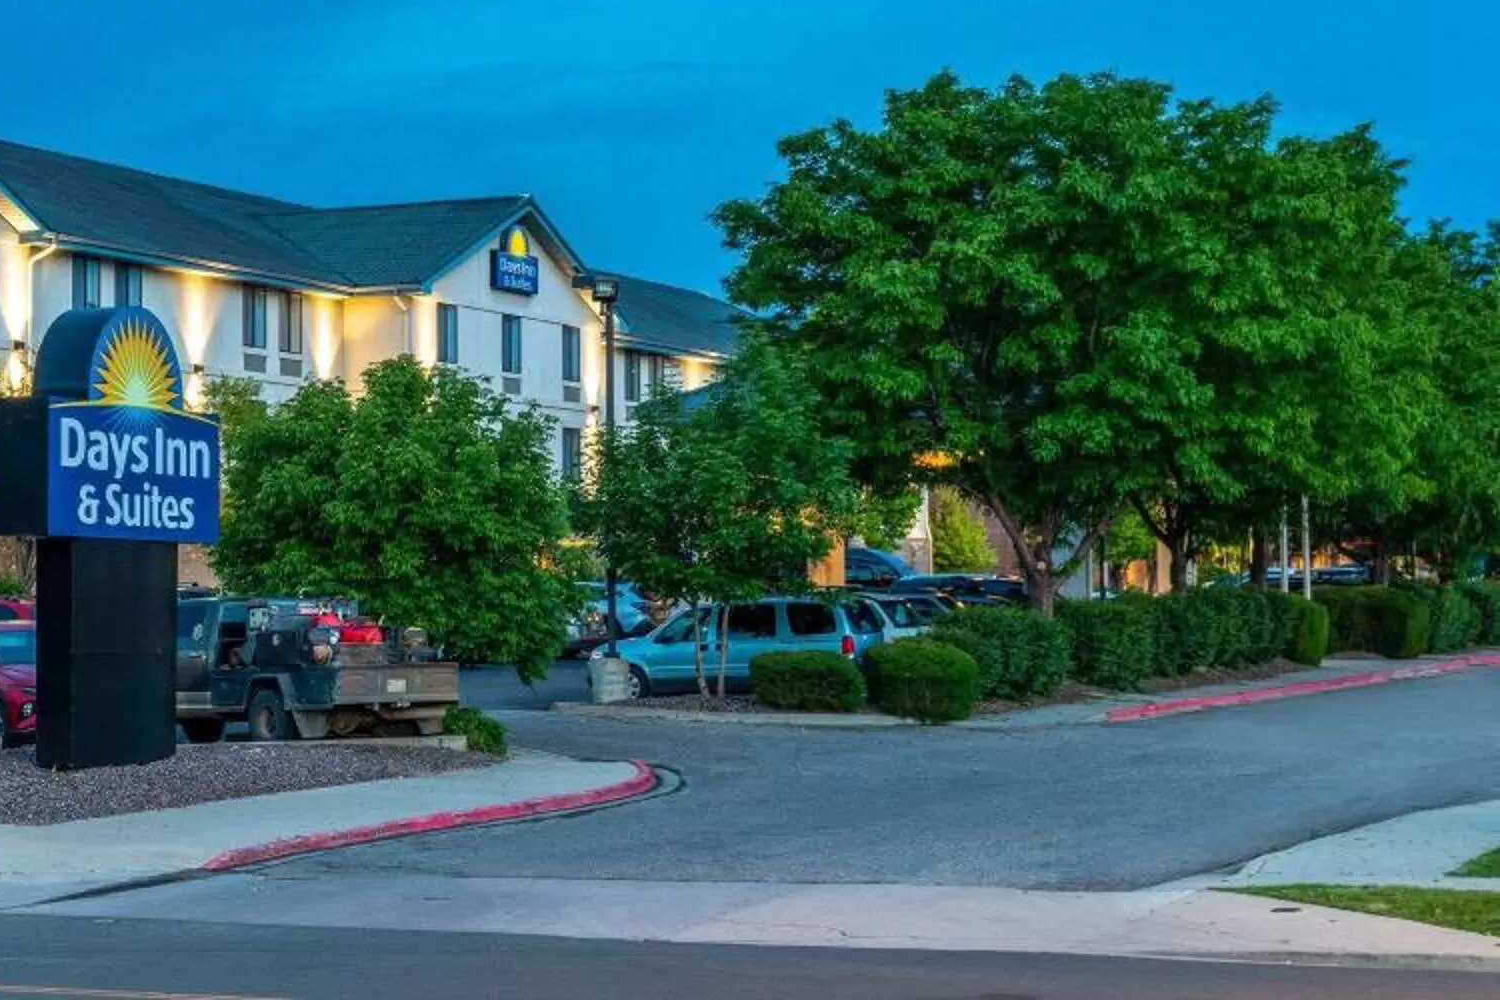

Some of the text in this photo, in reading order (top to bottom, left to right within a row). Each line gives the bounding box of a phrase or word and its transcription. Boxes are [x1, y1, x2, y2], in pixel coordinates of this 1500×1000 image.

[59, 417, 211, 479] Days Inn
[77, 481, 195, 530] & Suites
